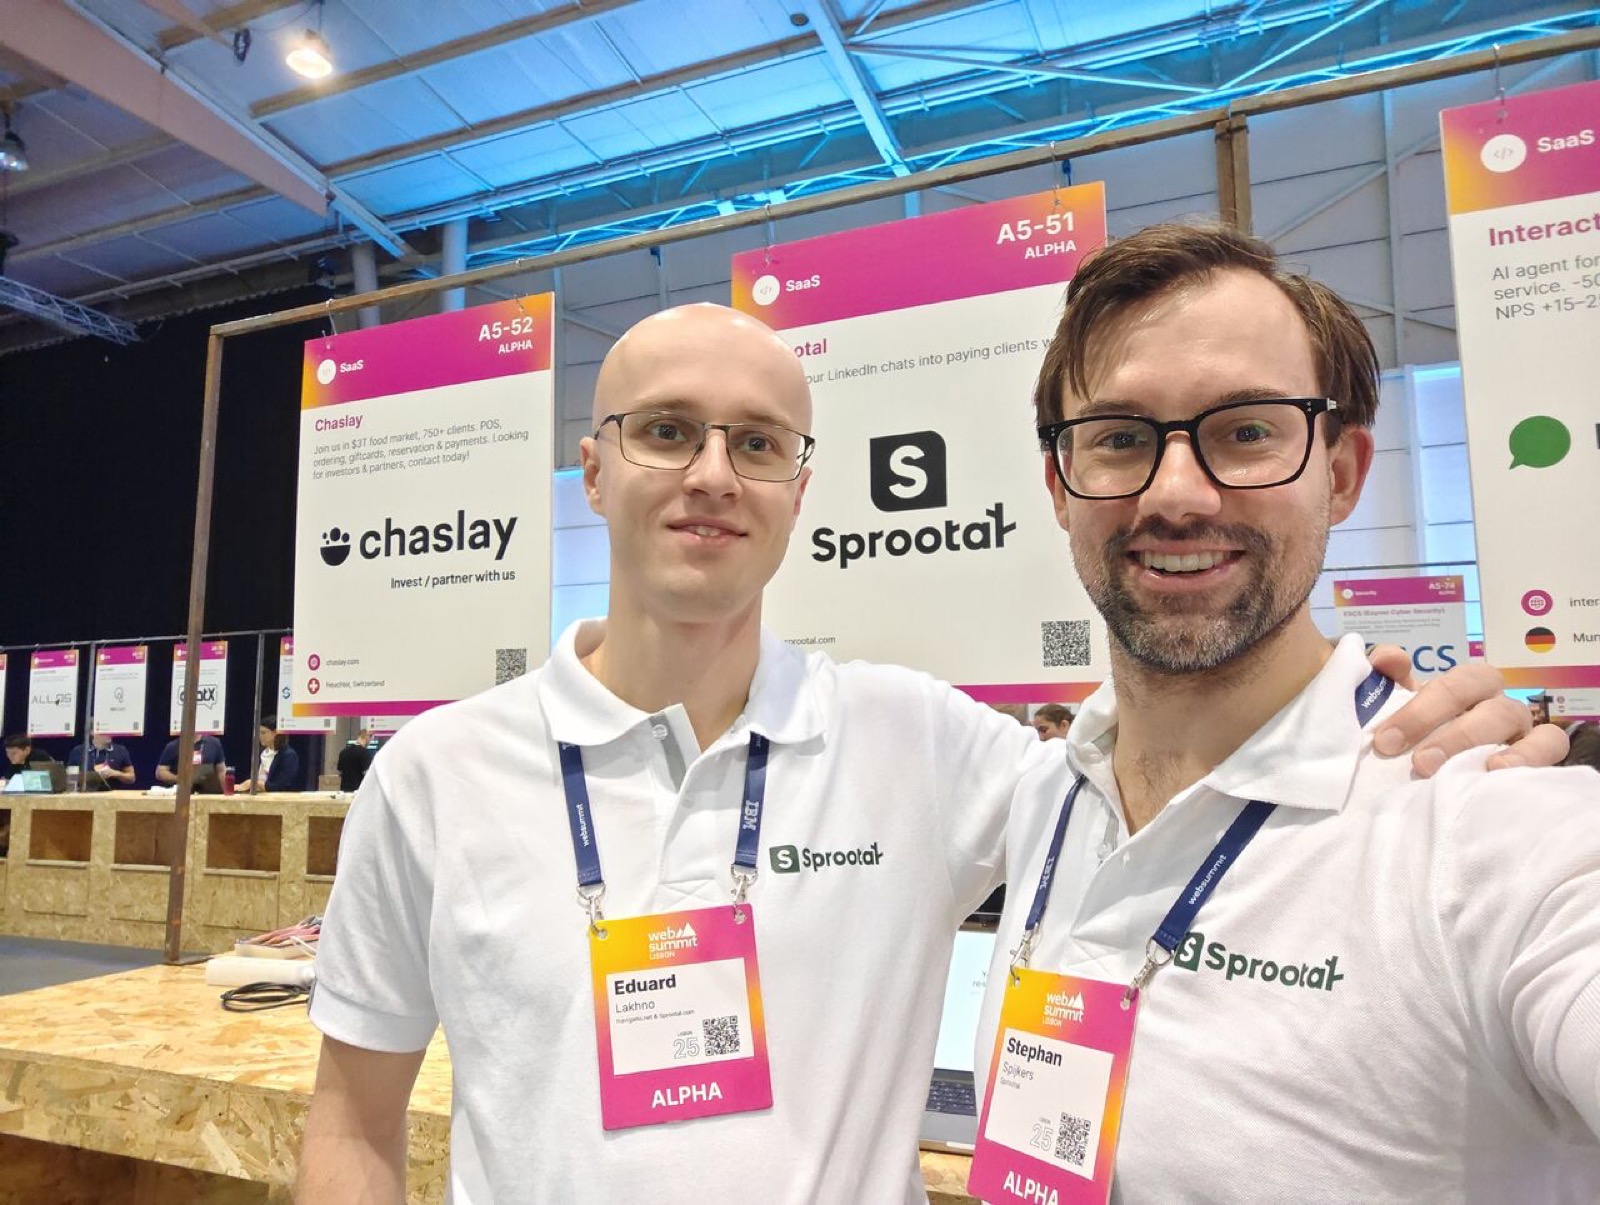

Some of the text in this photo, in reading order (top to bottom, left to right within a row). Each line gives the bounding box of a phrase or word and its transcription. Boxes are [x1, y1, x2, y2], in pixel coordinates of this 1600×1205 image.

[1536, 129, 1596, 153] SaaS
[996, 212, 1075, 246] A5-51
[1023, 239, 1078, 261] ALPHA
[1491, 266, 1509, 281] AI
[1515, 259, 1570, 280] agent
[785, 274, 821, 293] SaaS
[1493, 280, 1566, 301] service.
[1495, 302, 1536, 320] NPS
[478, 315, 534, 343] A5-52
[498, 339, 533, 356] ALPHA
[339, 358, 364, 374] SaaS
[828, 364, 878, 381] LinkedIn
[880, 358, 915, 373] chats
[918, 354, 943, 367] into
[946, 346, 990, 365] paying
[993, 339, 1038, 356] clients
[315, 414, 363, 432] Chaslay
[314, 444, 330, 455] Join
[331, 444, 340, 452] us
[342, 441, 350, 450] in
[369, 435, 388, 446] food
[389, 431, 421, 444] market,
[480, 418, 502, 431] POS,
[313, 455, 347, 467] ordering,
[349, 450, 386, 465] giftcards,
[388, 442, 435, 457] reservation
[436, 440, 443, 450] &
[492, 430, 530, 442] Looking
[313, 450, 470, 480] for investors & partners, contact today!
[360, 509, 519, 562] chaslay
[811, 502, 1017, 570] Sprootal
[391, 576, 423, 589] Invest
[431, 571, 474, 589] partner
[475, 569, 501, 582] with
[502, 569, 516, 581] us
[802, 842, 884, 872] Sprootal
[1188, 854, 1227, 905] websummit
[648, 926, 676, 941] web
[648, 936, 698, 952] summit
[1204, 942, 1345, 992] Sprootal
[614, 974, 677, 996] Eduard
[615, 1000, 656, 1014] Lakhno
[1046, 991, 1069, 1006] web
[1043, 1004, 1085, 1023] summit
[672, 1037, 701, 1060] 25
[1006, 1036, 1063, 1067] Stephan
[1002, 1060, 1035, 1081] Spijkers
[652, 1081, 723, 1109] ALPHA
[1029, 1122, 1054, 1152] 25
[1002, 1170, 1059, 1205] ALPHA
